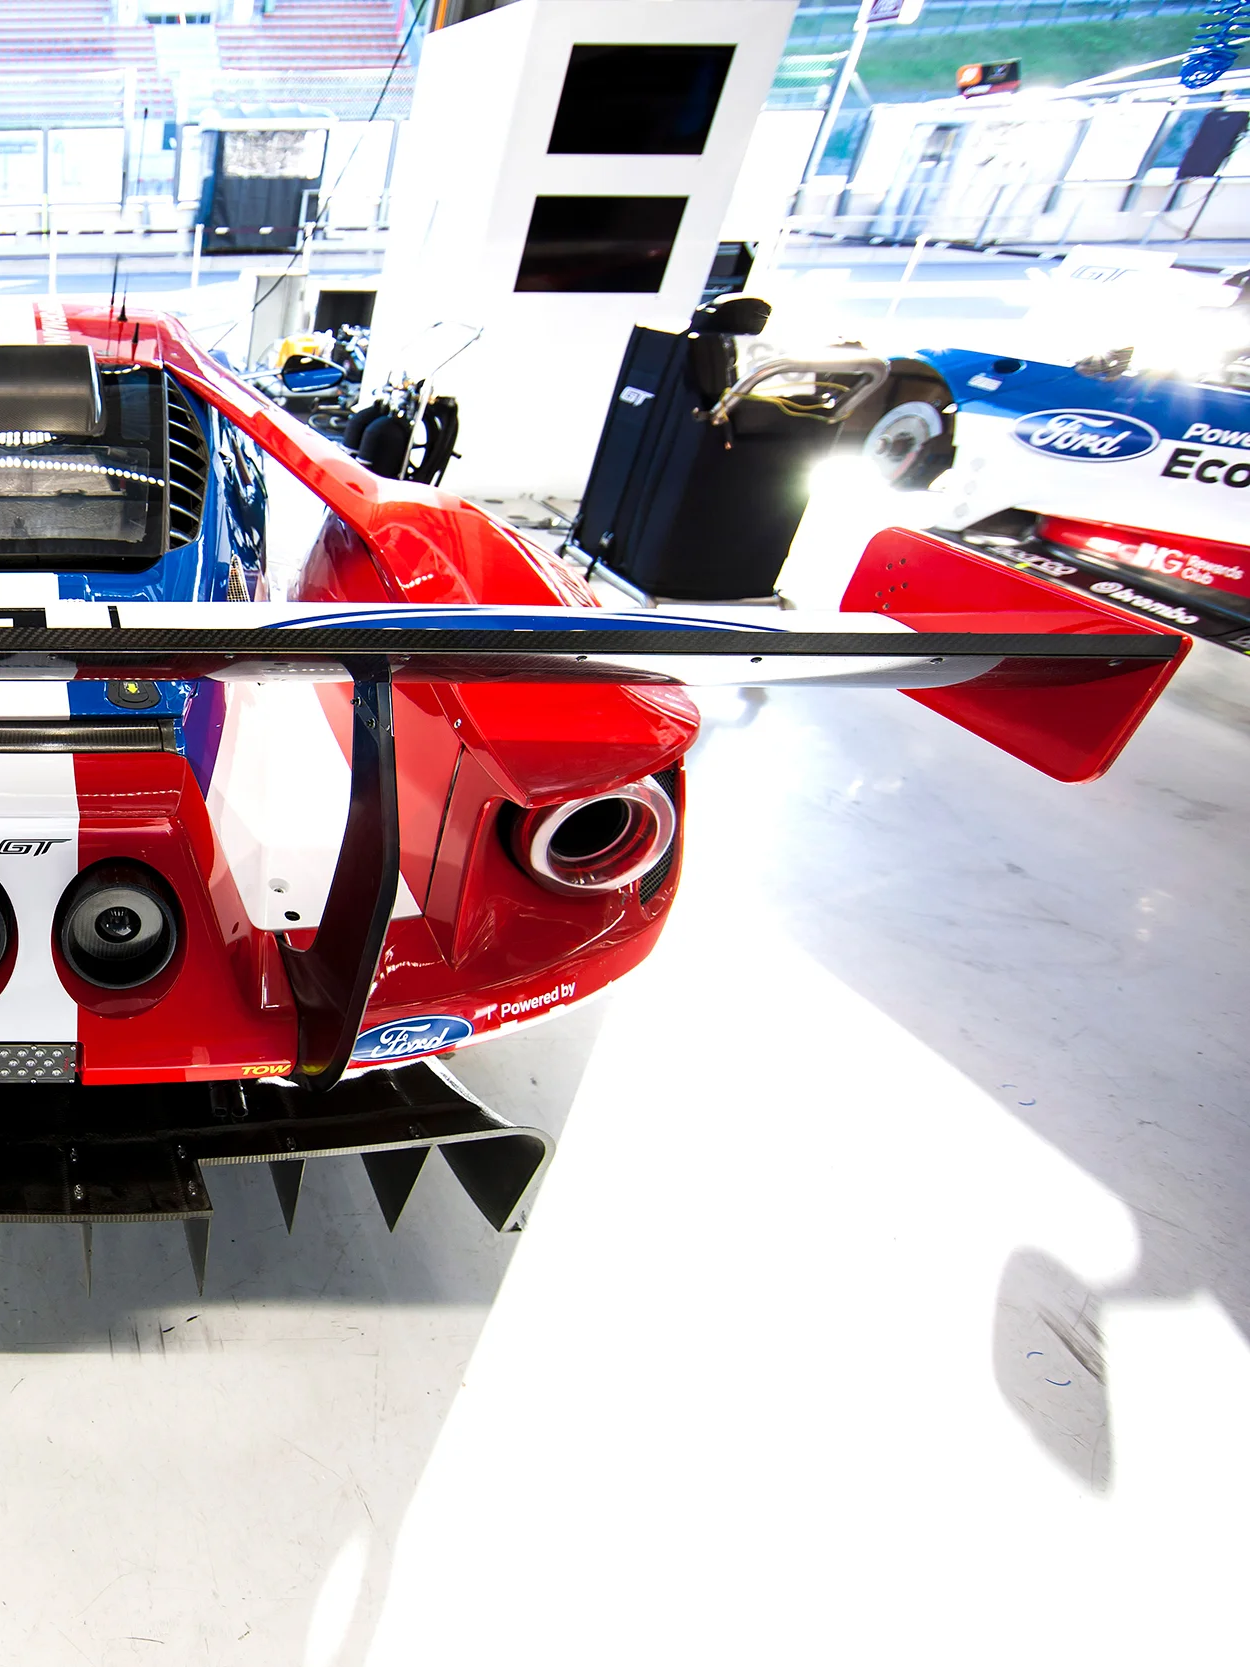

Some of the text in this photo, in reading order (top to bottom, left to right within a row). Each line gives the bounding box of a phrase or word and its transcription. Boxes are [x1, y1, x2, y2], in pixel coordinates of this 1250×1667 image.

[619, 385, 656, 407] GT
[1029, 413, 1132, 456] Ford
[501, 986, 560, 1018] Powered
[560, 981, 576, 998] by
[370, 1023, 450, 1058] Ford
[241, 1064, 291, 1075] TOW
